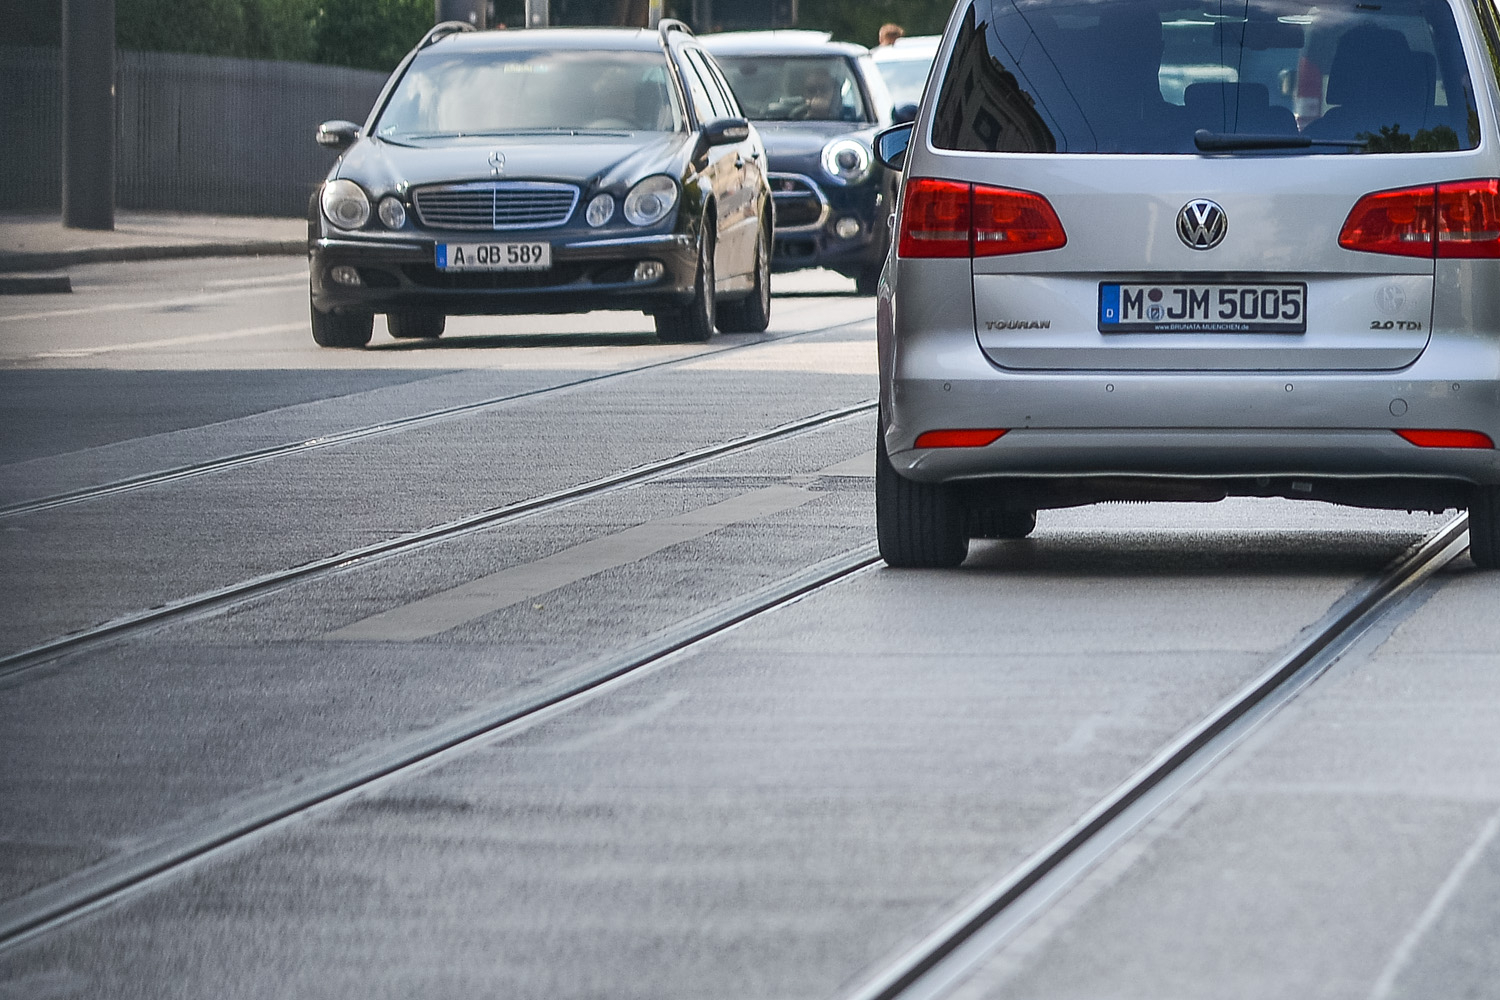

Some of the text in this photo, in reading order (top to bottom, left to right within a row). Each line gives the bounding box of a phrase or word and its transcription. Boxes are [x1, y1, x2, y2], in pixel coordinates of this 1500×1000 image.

[454, 244, 542, 265] A QB 589
[1122, 288, 1301, 320] M JM 5005
[1106, 308, 1114, 318] D
[985, 319, 1051, 330] TOURAN
[1370, 320, 1422, 331] 2.0 TDI
